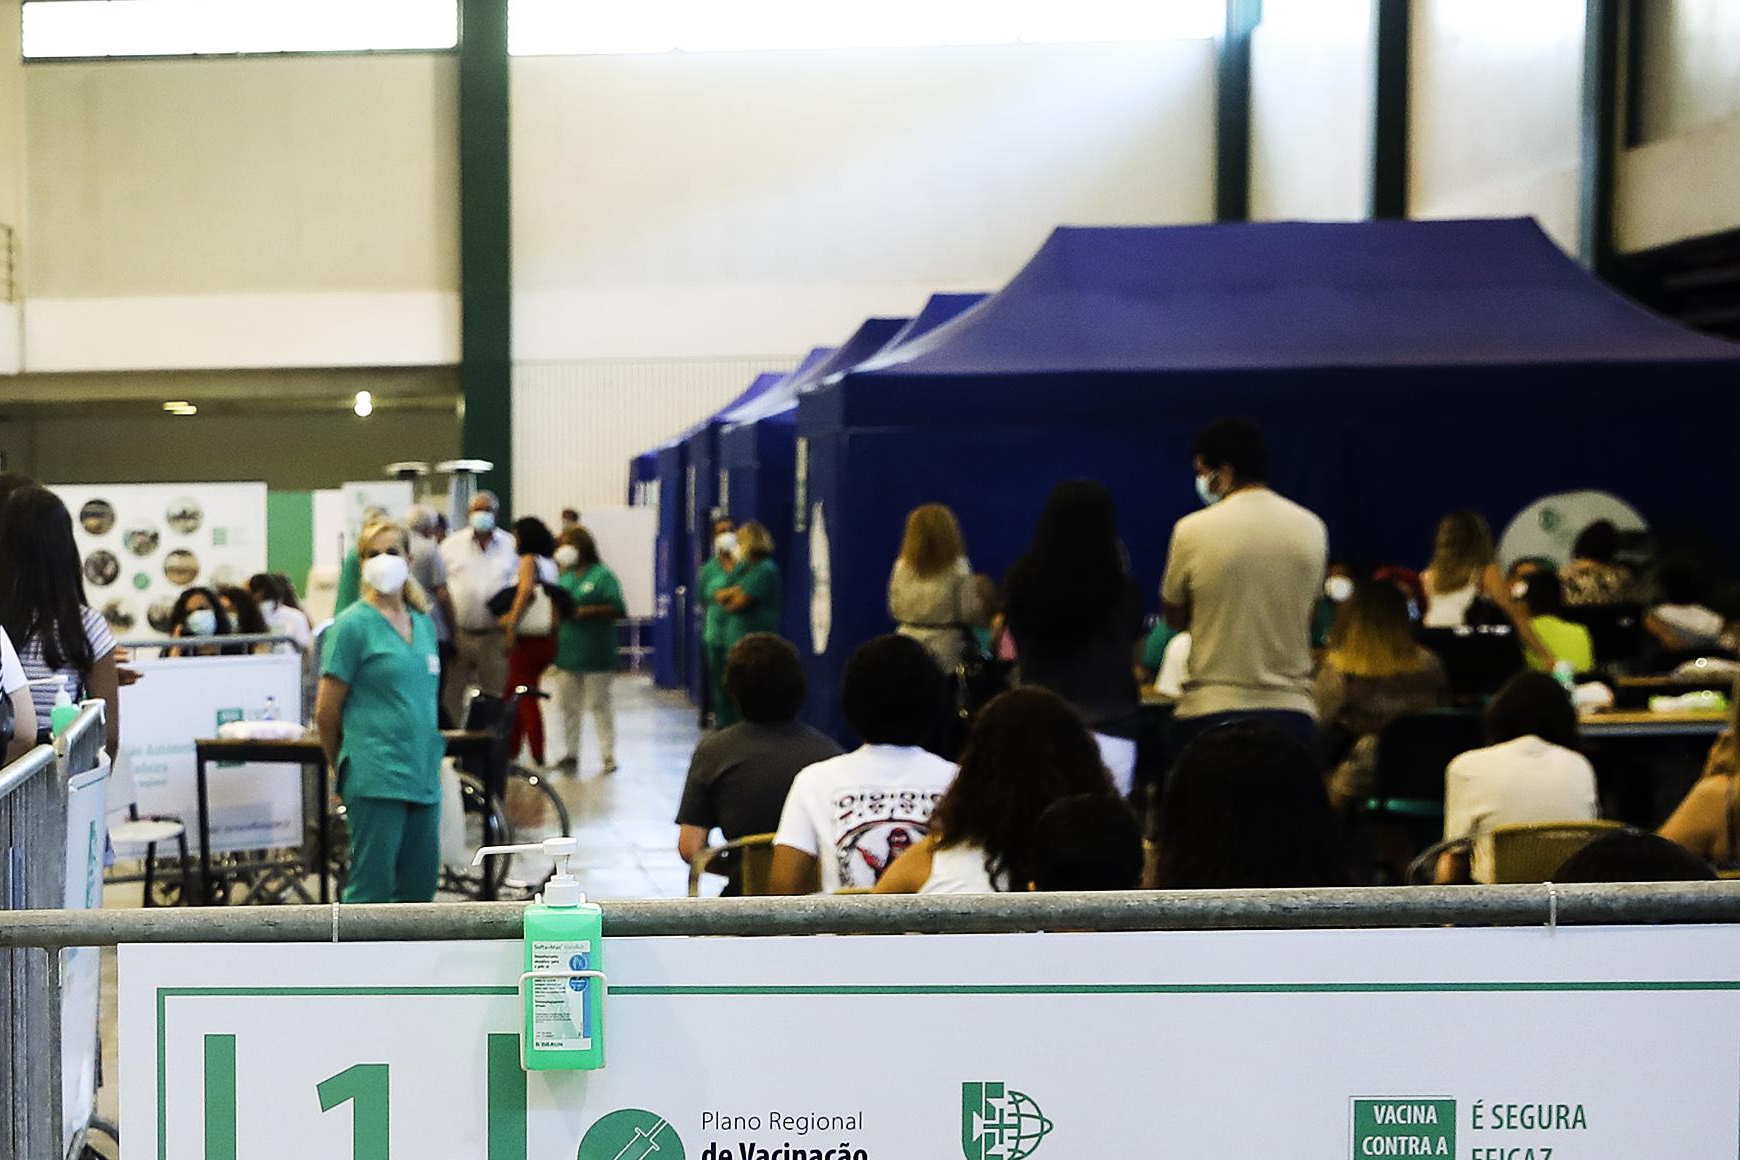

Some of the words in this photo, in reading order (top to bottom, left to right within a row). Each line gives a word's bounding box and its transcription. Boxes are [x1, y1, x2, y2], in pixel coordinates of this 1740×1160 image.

[702, 1111, 760, 1131] Plano
[769, 1111, 862, 1136] Regional
[1373, 1104, 1438, 1125] VACINA
[1472, 1099, 1484, 1130] É
[1491, 1104, 1587, 1130] SEGURA
[1362, 1136, 1431, 1156] CONTRA
[1435, 1136, 1448, 1155] A
